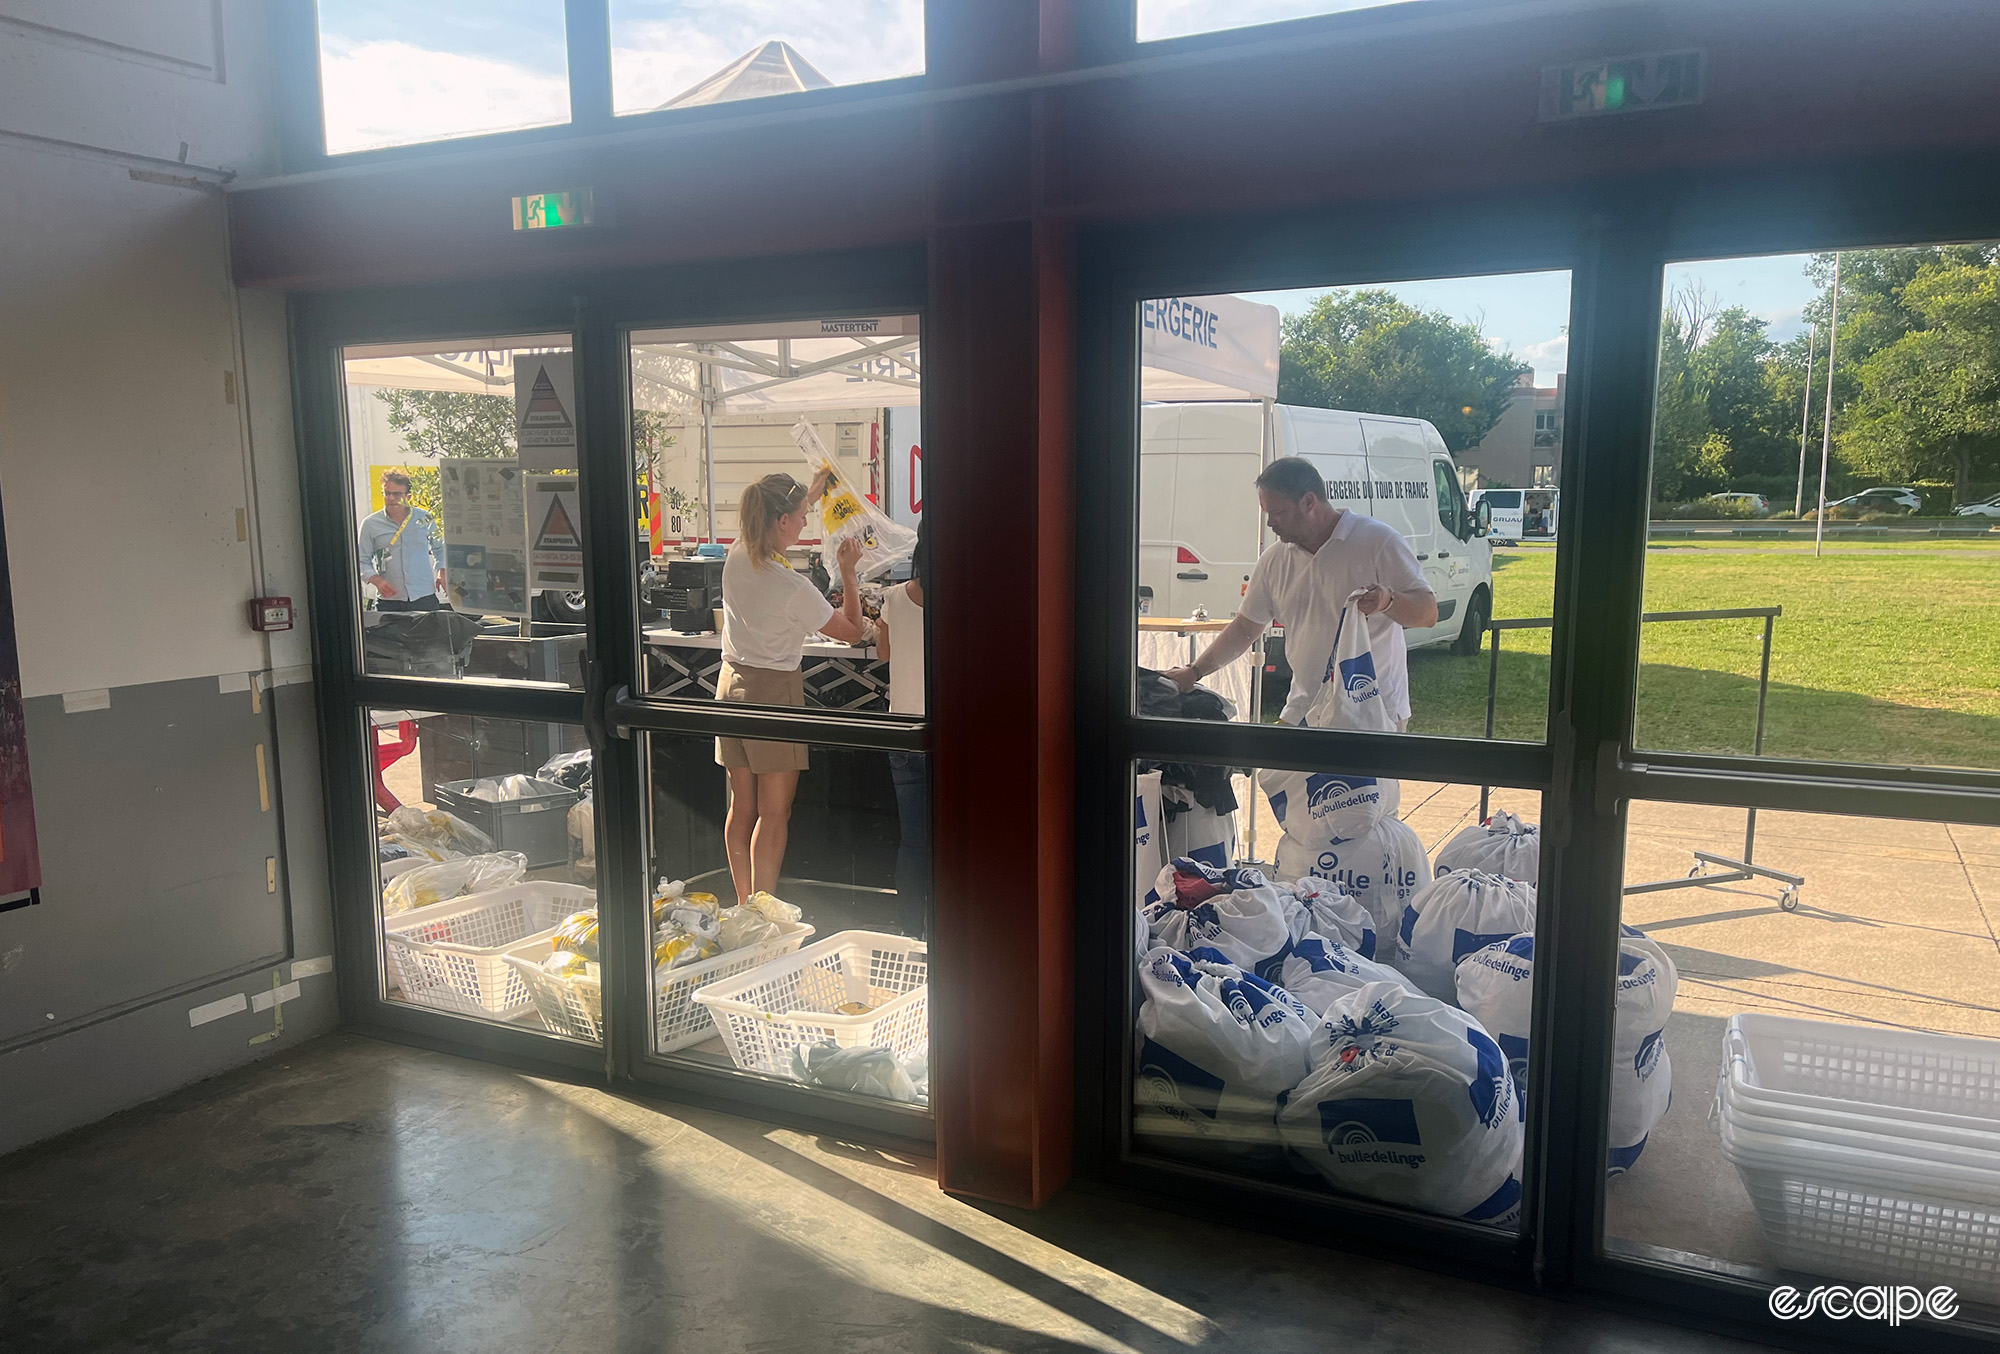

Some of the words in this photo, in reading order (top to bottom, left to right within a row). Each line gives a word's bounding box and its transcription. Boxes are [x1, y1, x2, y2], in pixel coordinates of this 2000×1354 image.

[821, 323, 878, 332] MASTERTENT
[1144, 297, 1218, 350] ERGERIE
[1326, 481, 1361, 500] IERGERIE
[1362, 481, 1374, 500] DU
[1375, 481, 1394, 499] TOUR
[1395, 481, 1404, 499] DE
[1405, 481, 1429, 499] FRANCE
[671, 516, 681, 533] 80
[1324, 791, 1380, 813] bulledelinge
[1338, 1150, 1426, 1169] bulledelinge
